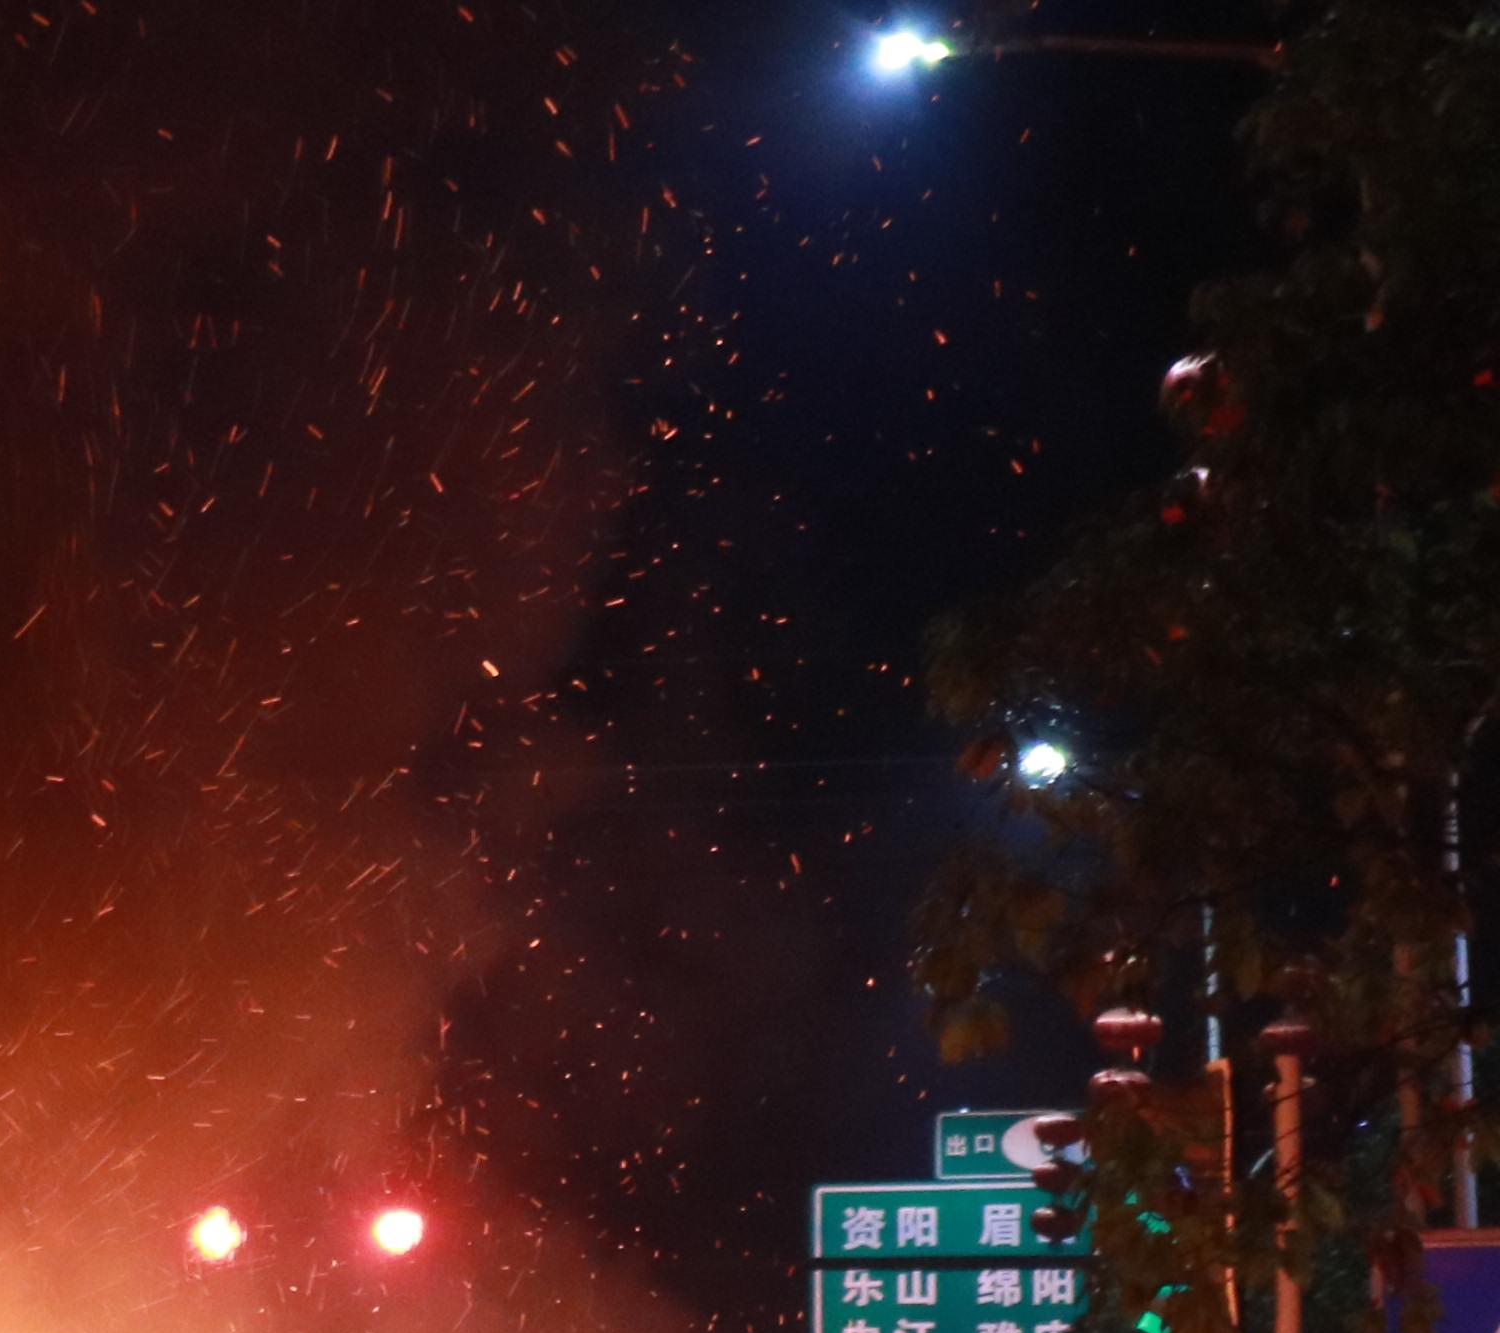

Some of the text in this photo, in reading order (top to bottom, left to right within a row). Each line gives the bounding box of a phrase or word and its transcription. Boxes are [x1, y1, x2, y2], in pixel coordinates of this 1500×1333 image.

[945, 1134, 996, 1157] 出口
[841, 1203, 1077, 1251] 资阳 眉
[841, 1268, 1077, 1307] 乐山 绵阳
